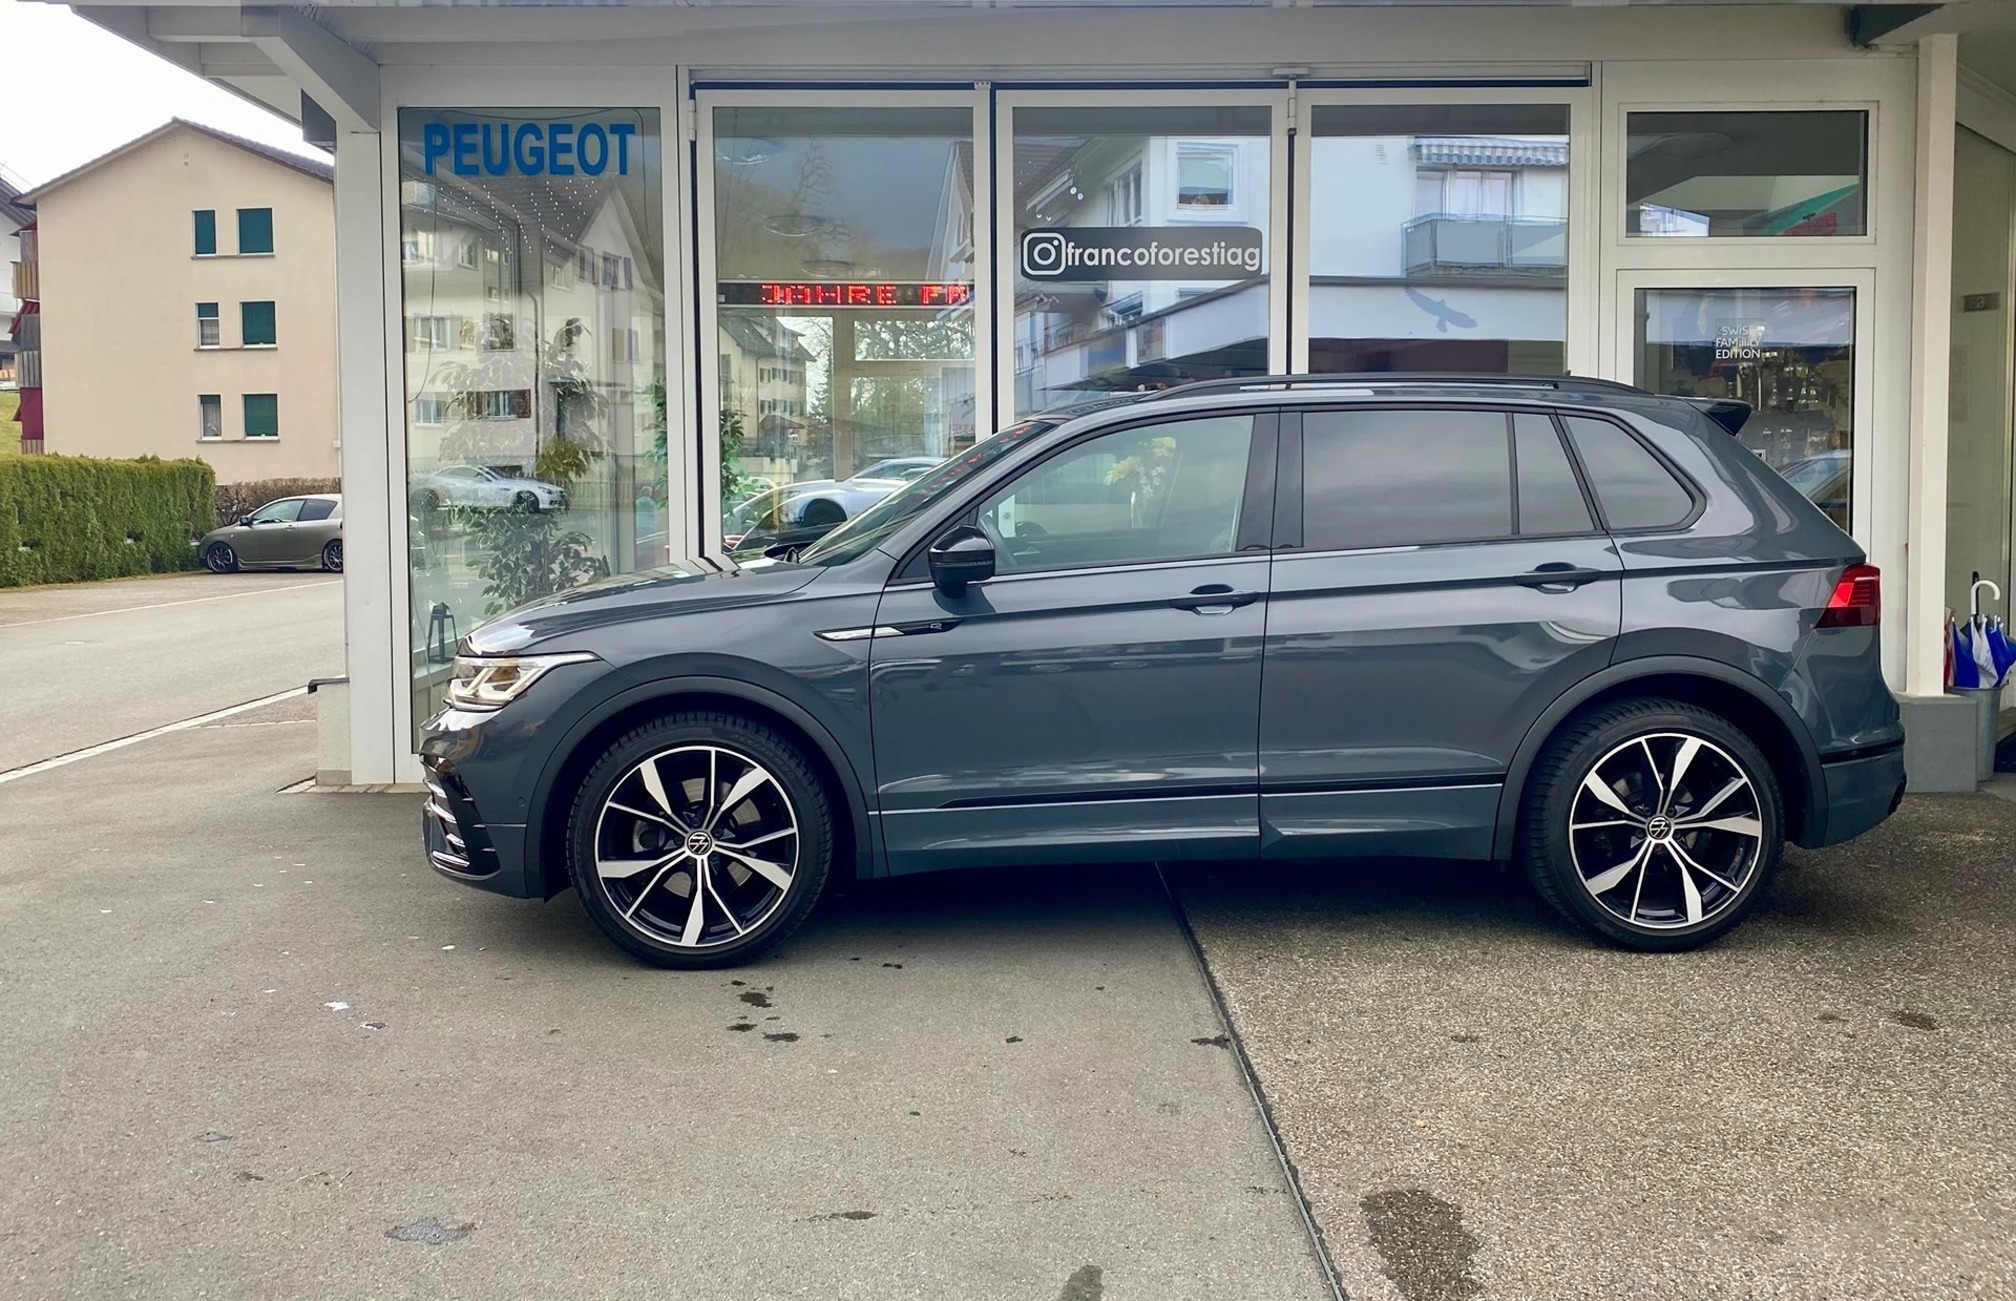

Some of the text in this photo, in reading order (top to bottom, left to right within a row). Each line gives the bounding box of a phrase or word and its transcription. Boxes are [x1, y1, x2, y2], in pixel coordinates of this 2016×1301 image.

[424, 122, 636, 176] PEUGEOT
[1066, 241, 1261, 272] francoforestiag
[761, 284, 897, 305] JAHRE
[1715, 349, 1761, 359] EDITION
